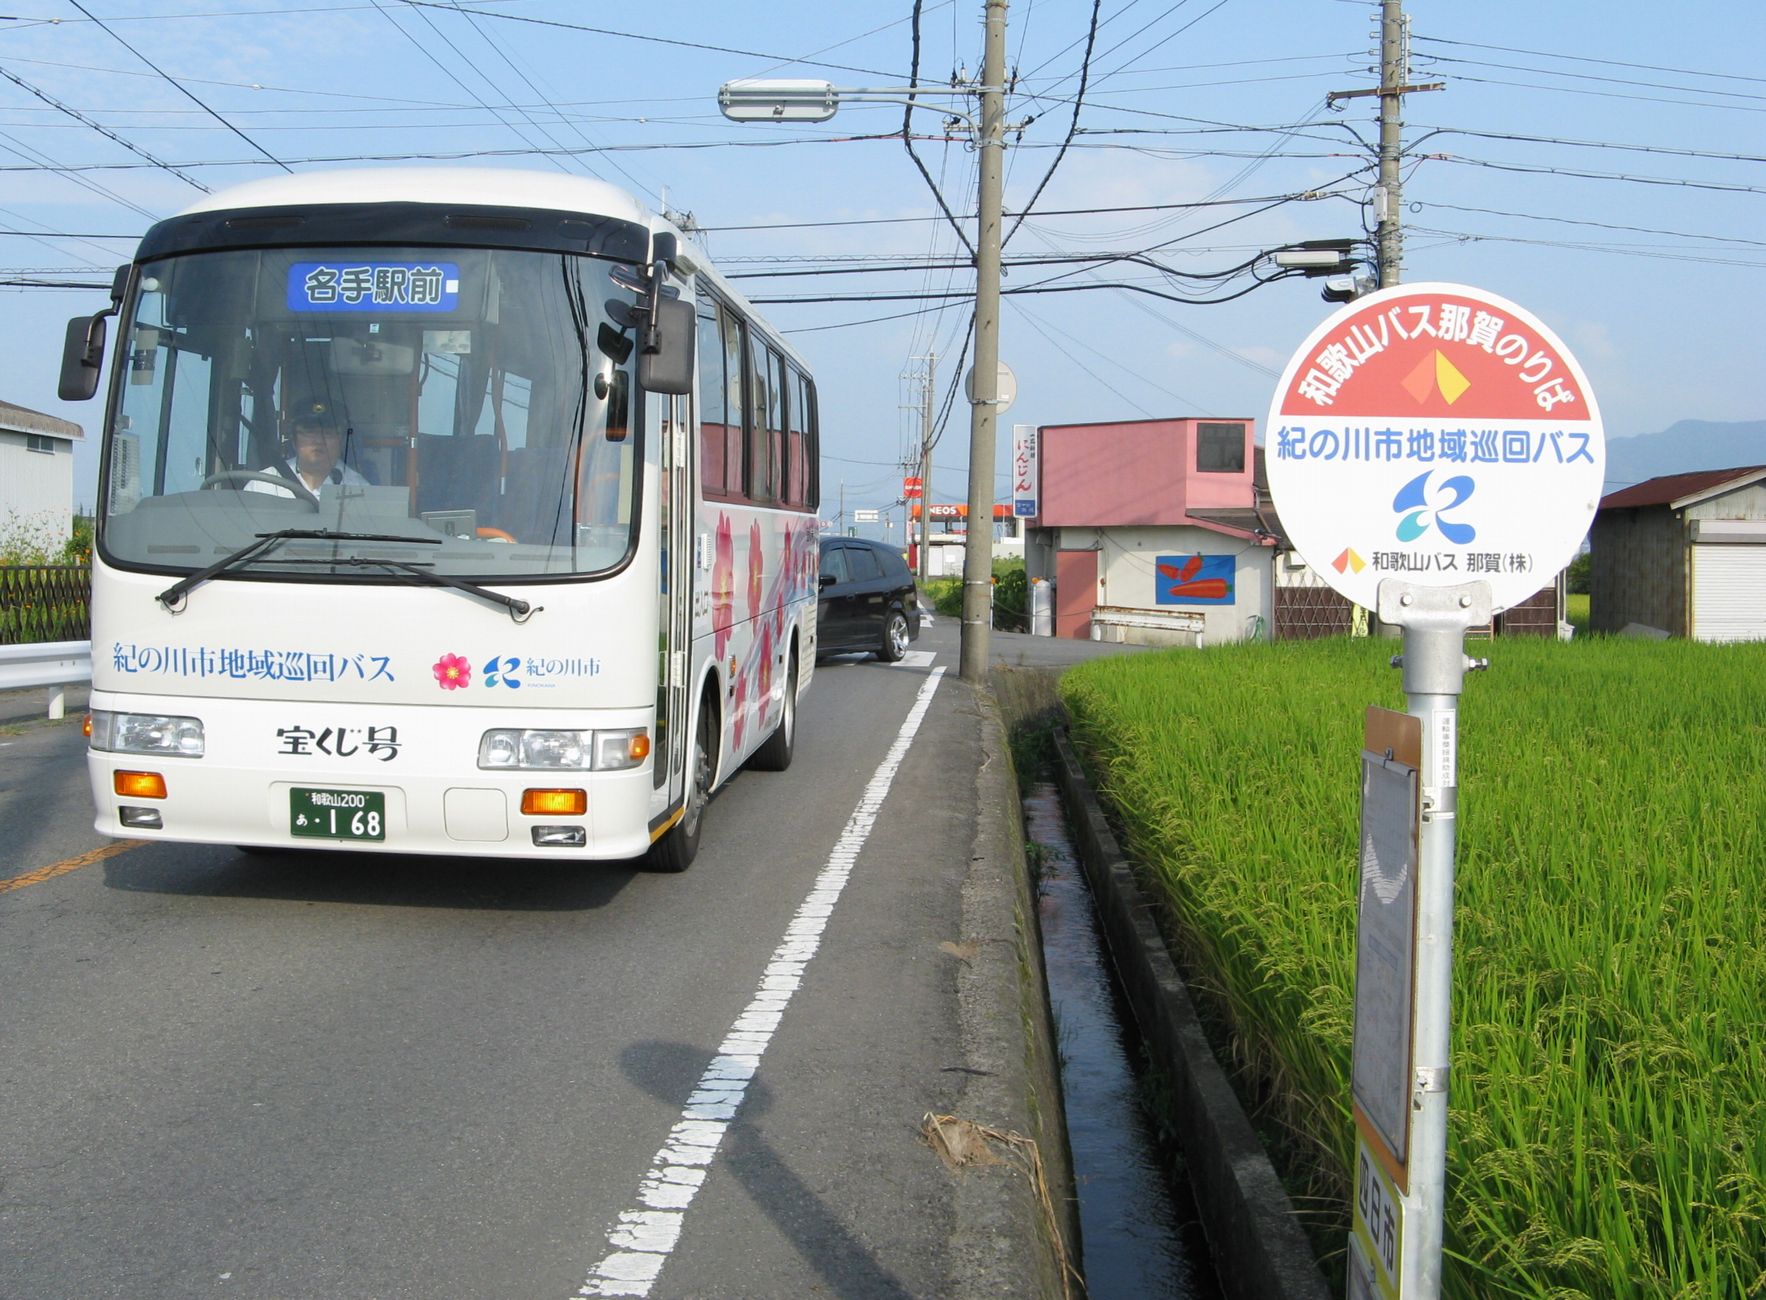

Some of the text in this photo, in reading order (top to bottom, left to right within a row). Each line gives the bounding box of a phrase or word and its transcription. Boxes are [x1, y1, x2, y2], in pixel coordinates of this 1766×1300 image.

[305, 266, 444, 305] 名手駅前
[1298, 303, 1575, 412] 和歌山バス那賀のりば
[1277, 426, 1595, 464] 紀の川市地域巡回バス
[1016, 439, 1032, 492] にんじん
[930, 506, 957, 515] NEOS
[1372, 551, 1458, 573] 和歌山バス
[112, 641, 396, 683] 紀の川市地域巡回バス
[526, 657, 601, 676] 紀の川市
[276, 725, 402, 763] 宝くじ号
[1359, 1151, 1395, 1271] 四日市
